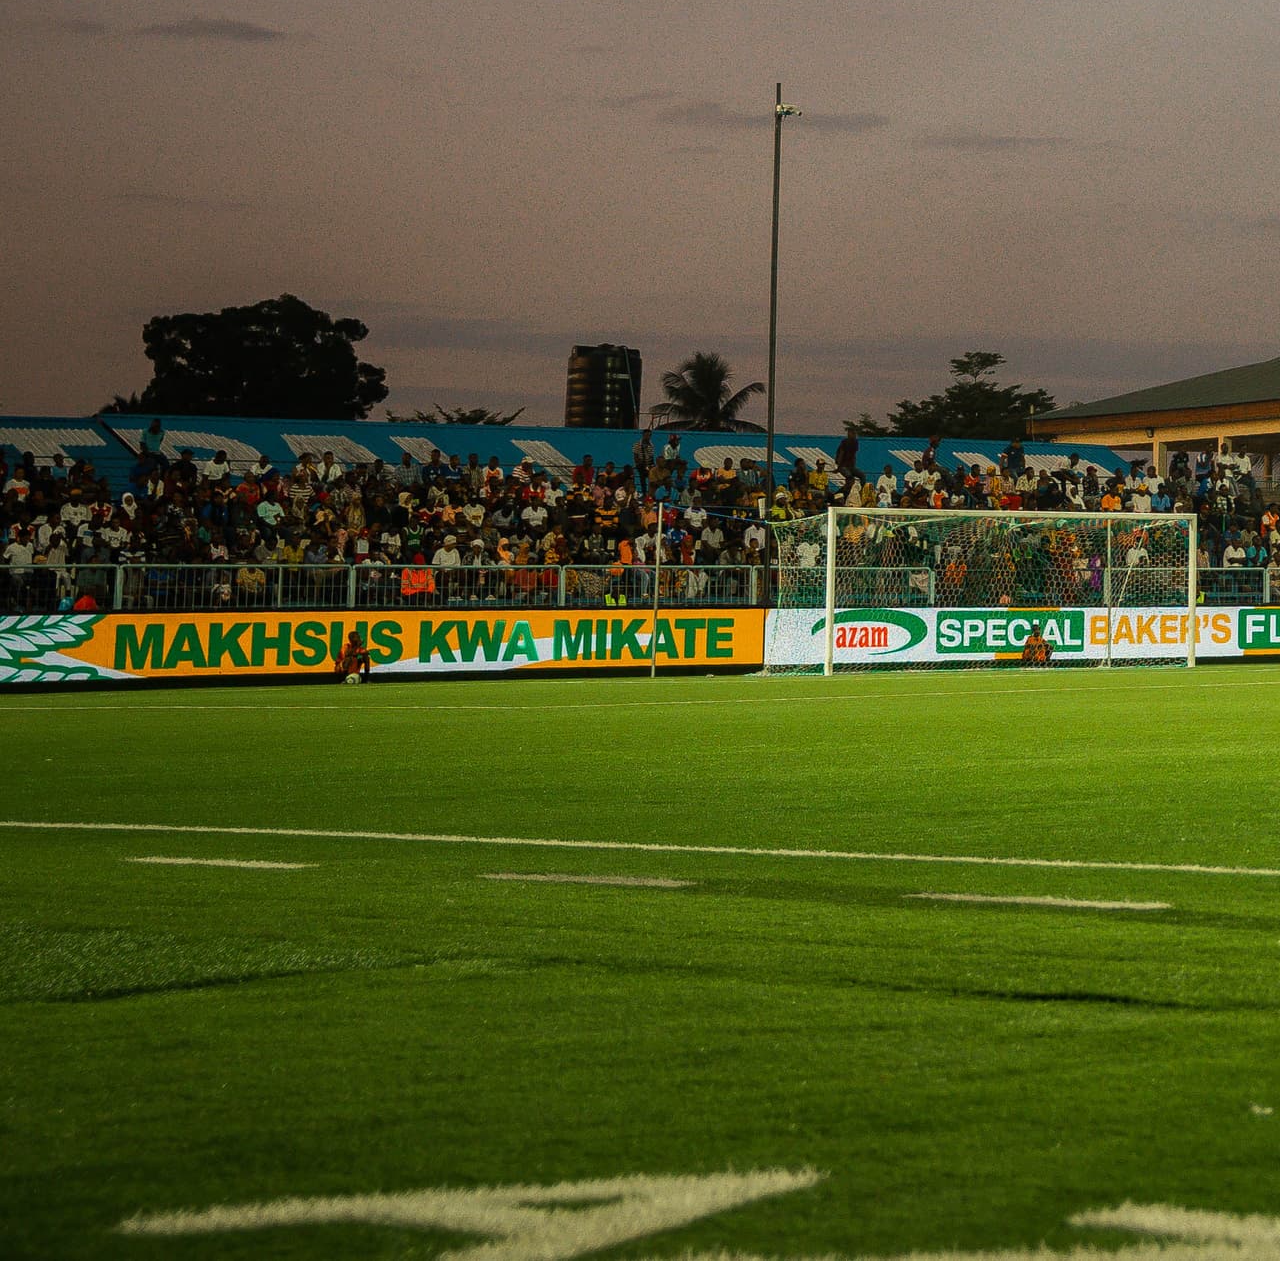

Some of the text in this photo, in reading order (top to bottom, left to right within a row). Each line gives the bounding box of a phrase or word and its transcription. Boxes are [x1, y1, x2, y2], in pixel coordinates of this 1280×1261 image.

[114, 618, 735, 670] MAKHSUS KWA MIKATE
[836, 626, 888, 648] azam
[939, 618, 1082, 646] SPECAL
